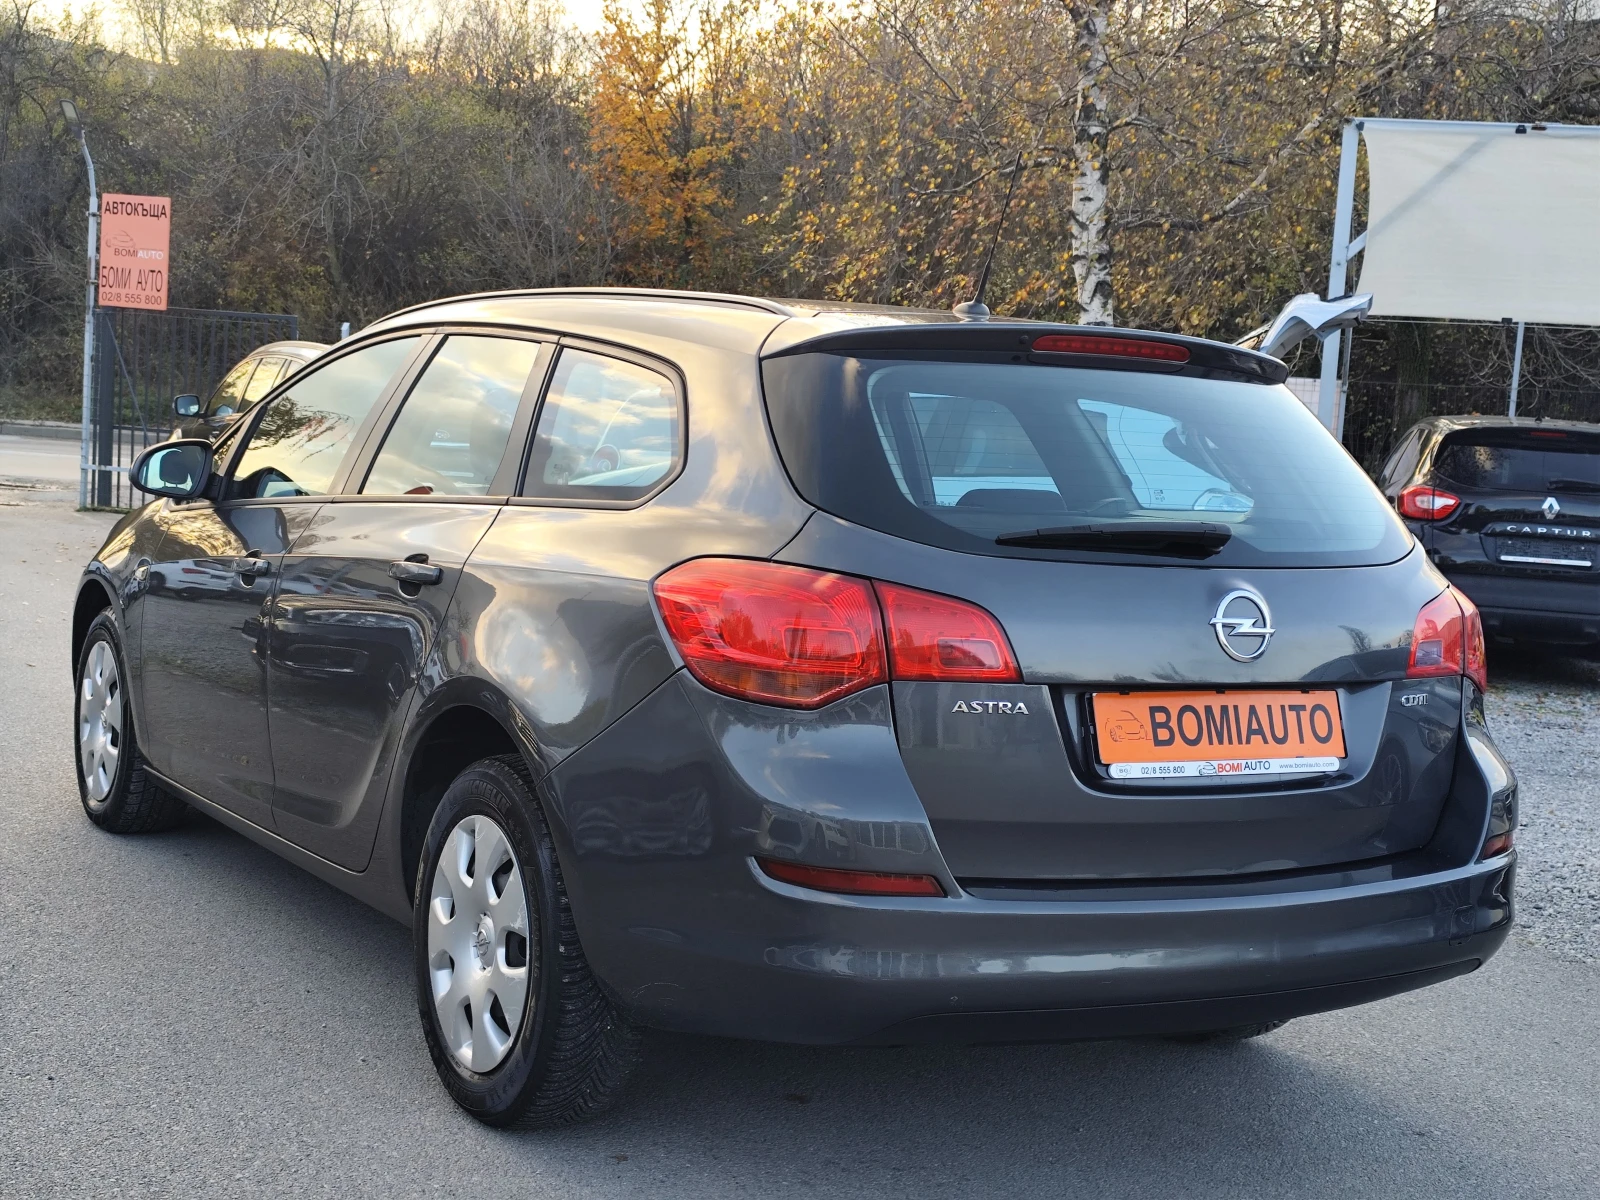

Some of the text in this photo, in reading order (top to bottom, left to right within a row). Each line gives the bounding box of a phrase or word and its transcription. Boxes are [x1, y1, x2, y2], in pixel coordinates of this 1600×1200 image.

[104, 201, 167, 219] АВТОКЪЩА
[114, 248, 163, 259] BOMIAUTO
[101, 266, 162, 292] БОМИ АУТО
[101, 292, 162, 305] 02/8 555 800
[1506, 525, 1592, 538] CAPTUR
[951, 700, 1029, 715] ASTRA
[1148, 703, 1334, 747] BOMIAUTO
[1140, 766, 1157, 775] 02/8
[1158, 766, 1172, 775] 555
[1173, 765, 1186, 774] 800
[1279, 761, 1335, 770] www.bomiauto.com
